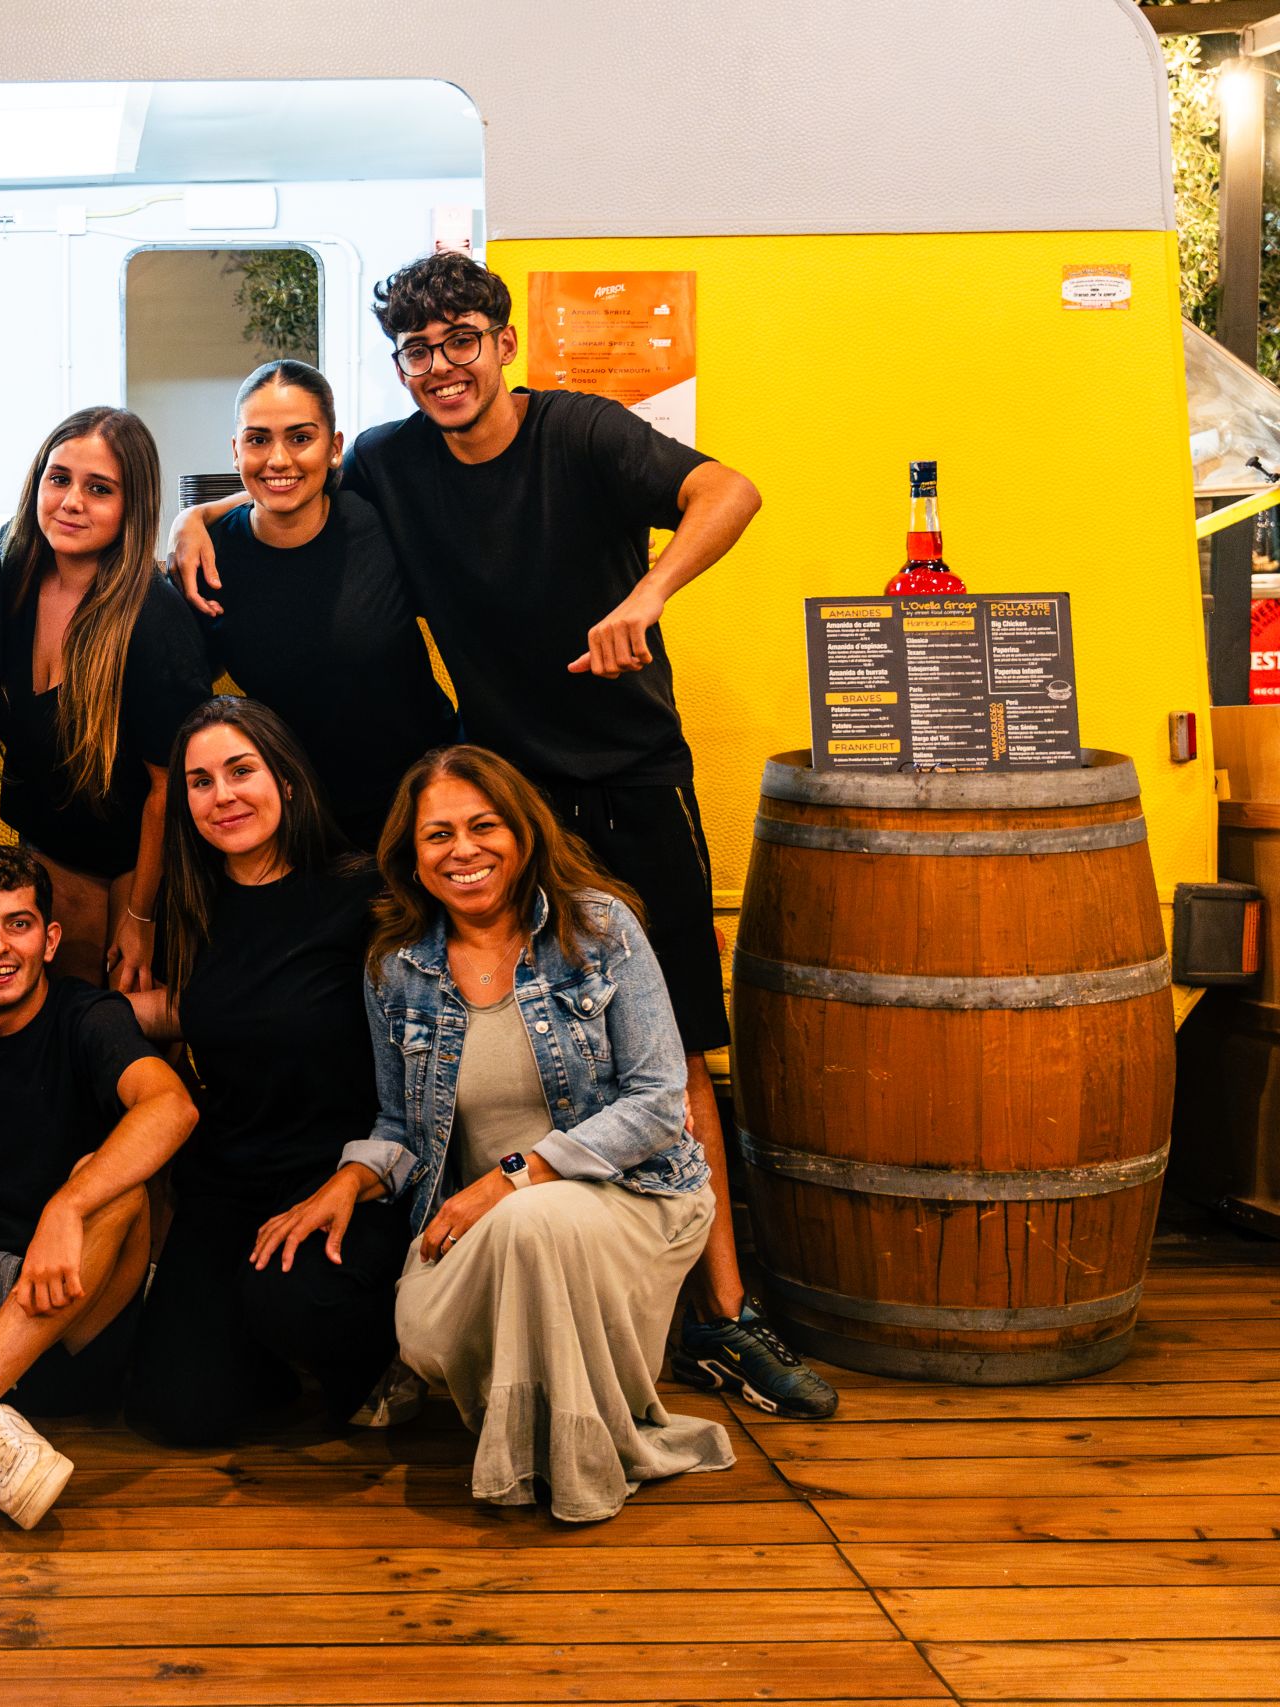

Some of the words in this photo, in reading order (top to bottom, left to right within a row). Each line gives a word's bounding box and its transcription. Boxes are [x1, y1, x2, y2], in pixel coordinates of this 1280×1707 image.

[594, 283, 626, 299] APEROL
[943, 600, 977, 614] Groga
[990, 603, 1051, 611] POLLASTRE
[829, 609, 882, 618] AMANIDES
[826, 621, 853, 629] Amanida
[991, 620, 1002, 628] Big
[992, 646, 1020, 655] Paperina
[994, 668, 1021, 676] Paperina
[1021, 667, 1044, 675] Infantil
[842, 694, 882, 703] BRAVES
[834, 742, 895, 752] FRANKFURT
